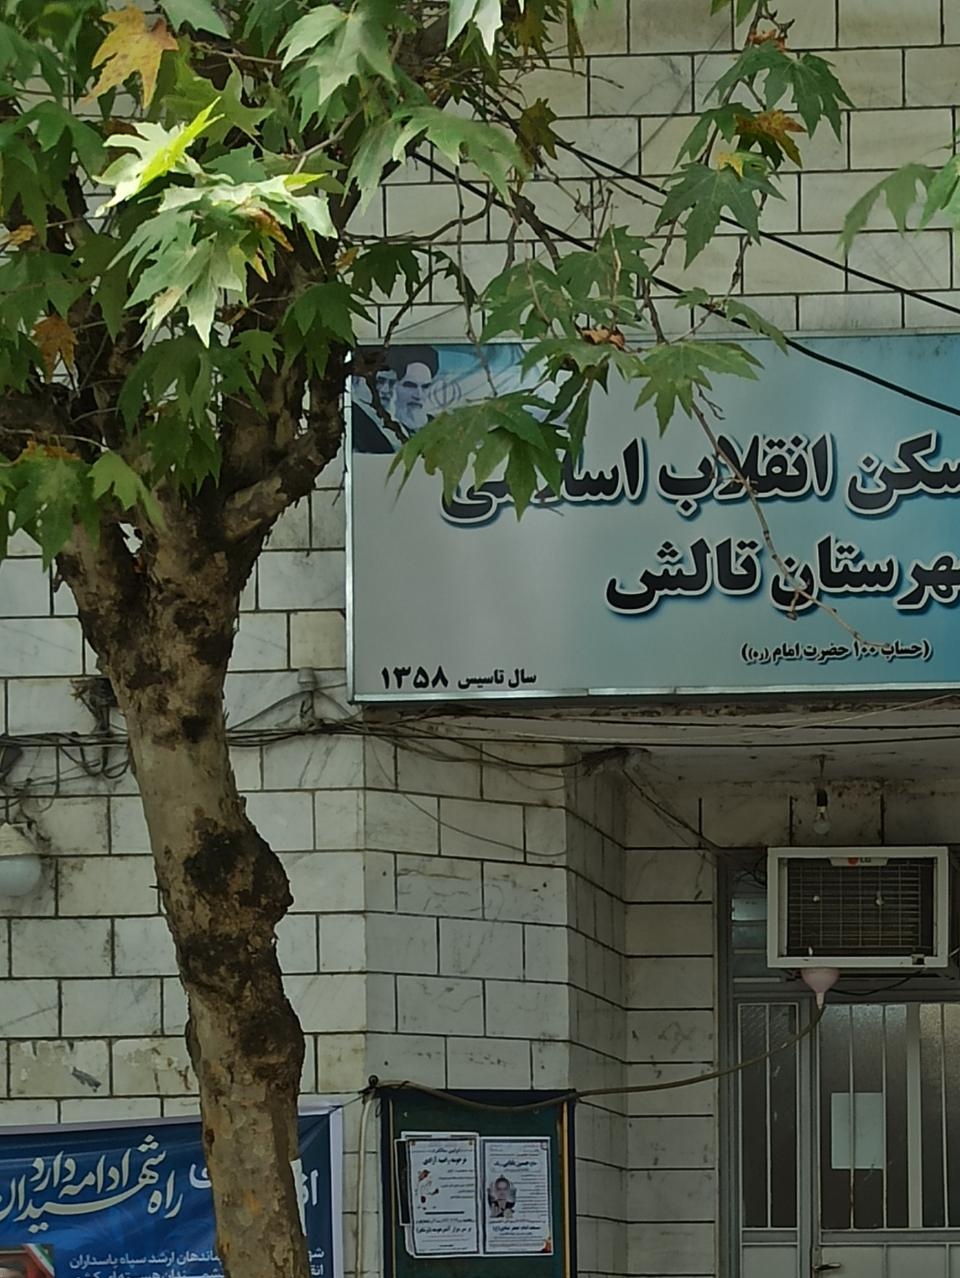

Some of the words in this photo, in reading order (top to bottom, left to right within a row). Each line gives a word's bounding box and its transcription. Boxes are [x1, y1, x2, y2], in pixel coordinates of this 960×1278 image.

[441, 437, 645, 525] اسلمی
[658, 433, 833, 516] انقلاب
[606, 537, 762, 616] تالش
[772, 643, 801, 666] امام
[803, 643, 849, 665] حضرت
[381, 665, 449, 690] ۱۳۵۸
[458, 670, 505, 689] تاسیس
[507, 668, 537, 689] سال
[30, 1151, 77, 1192] دارد
[58, 1148, 132, 1199] ادامه
[147, 1170, 184, 1219] راه
[69, 1254, 118, 1270] پاسداران
[120, 1253, 147, 1269] سپاه
[148, 1252, 174, 1267] ارشد
